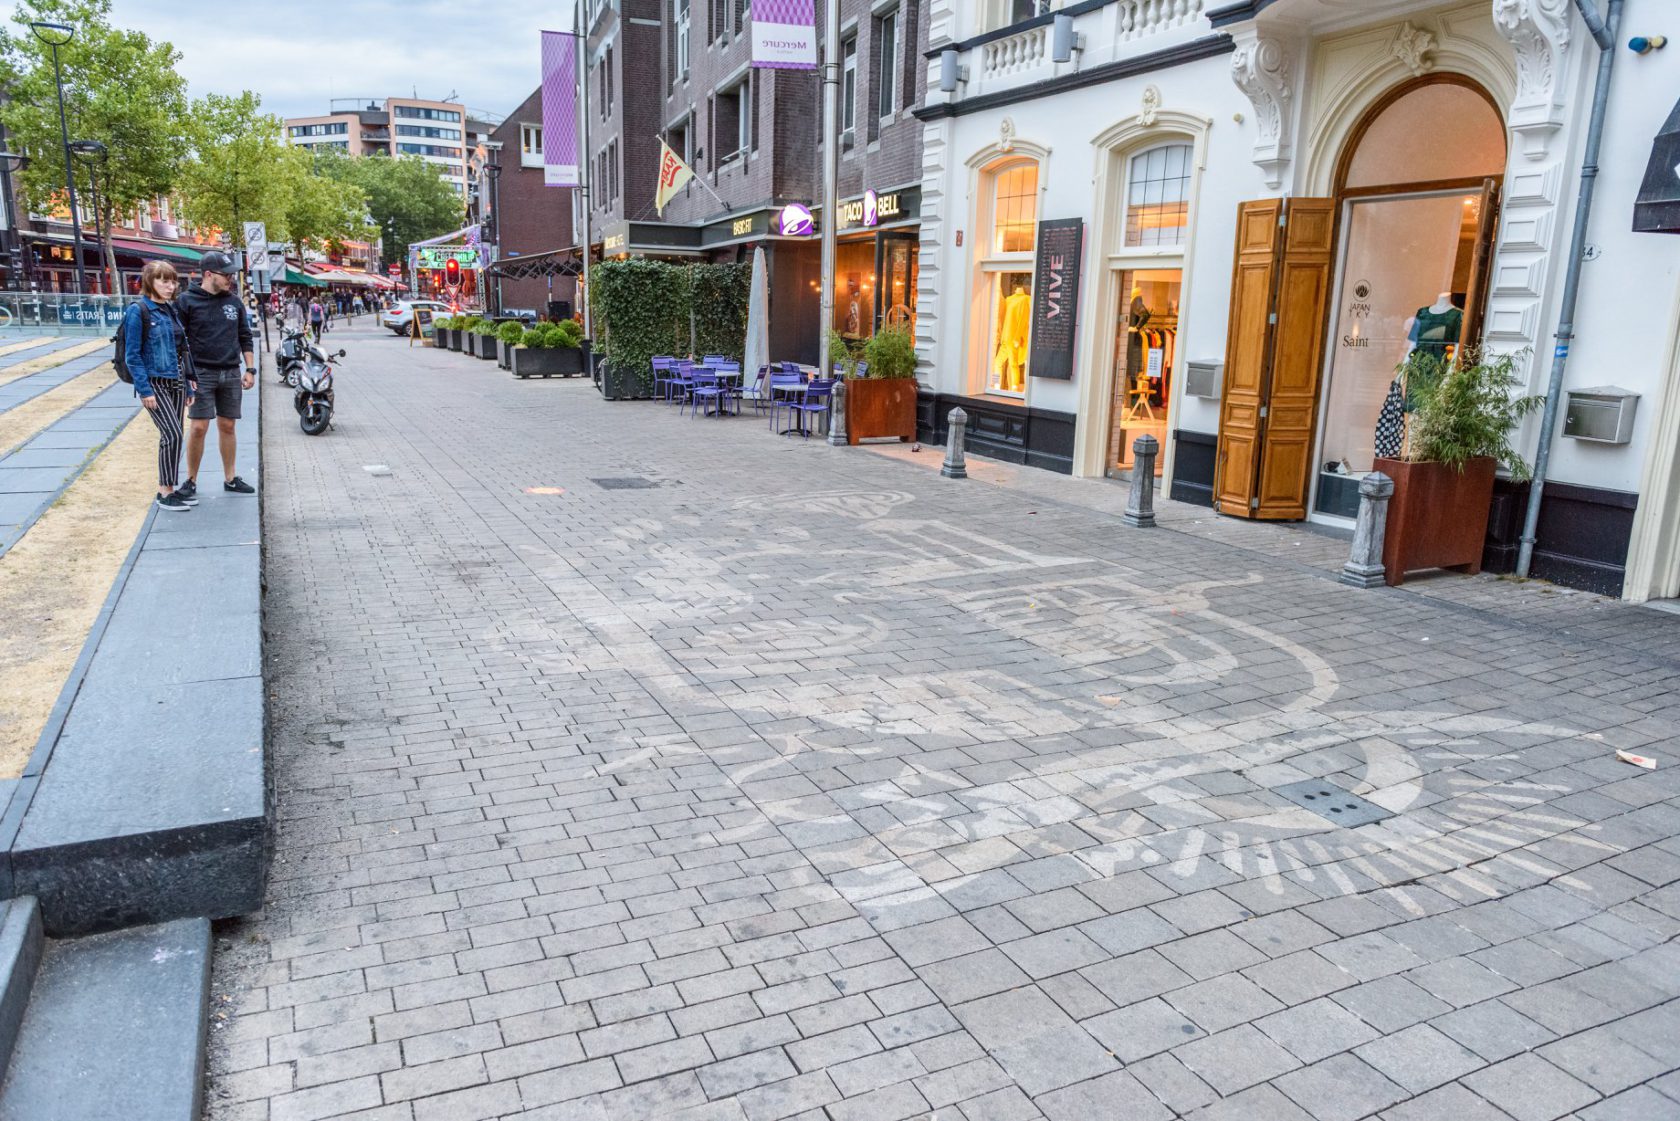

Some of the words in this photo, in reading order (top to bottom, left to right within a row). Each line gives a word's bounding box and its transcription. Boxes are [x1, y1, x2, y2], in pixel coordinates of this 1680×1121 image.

[844, 202, 863, 222] TACO
[878, 195, 899, 216] BELL
[1046, 254, 1064, 319] VIVE
[1350, 303, 1371, 311] JAPAN
[1343, 335, 1369, 347] Saint
